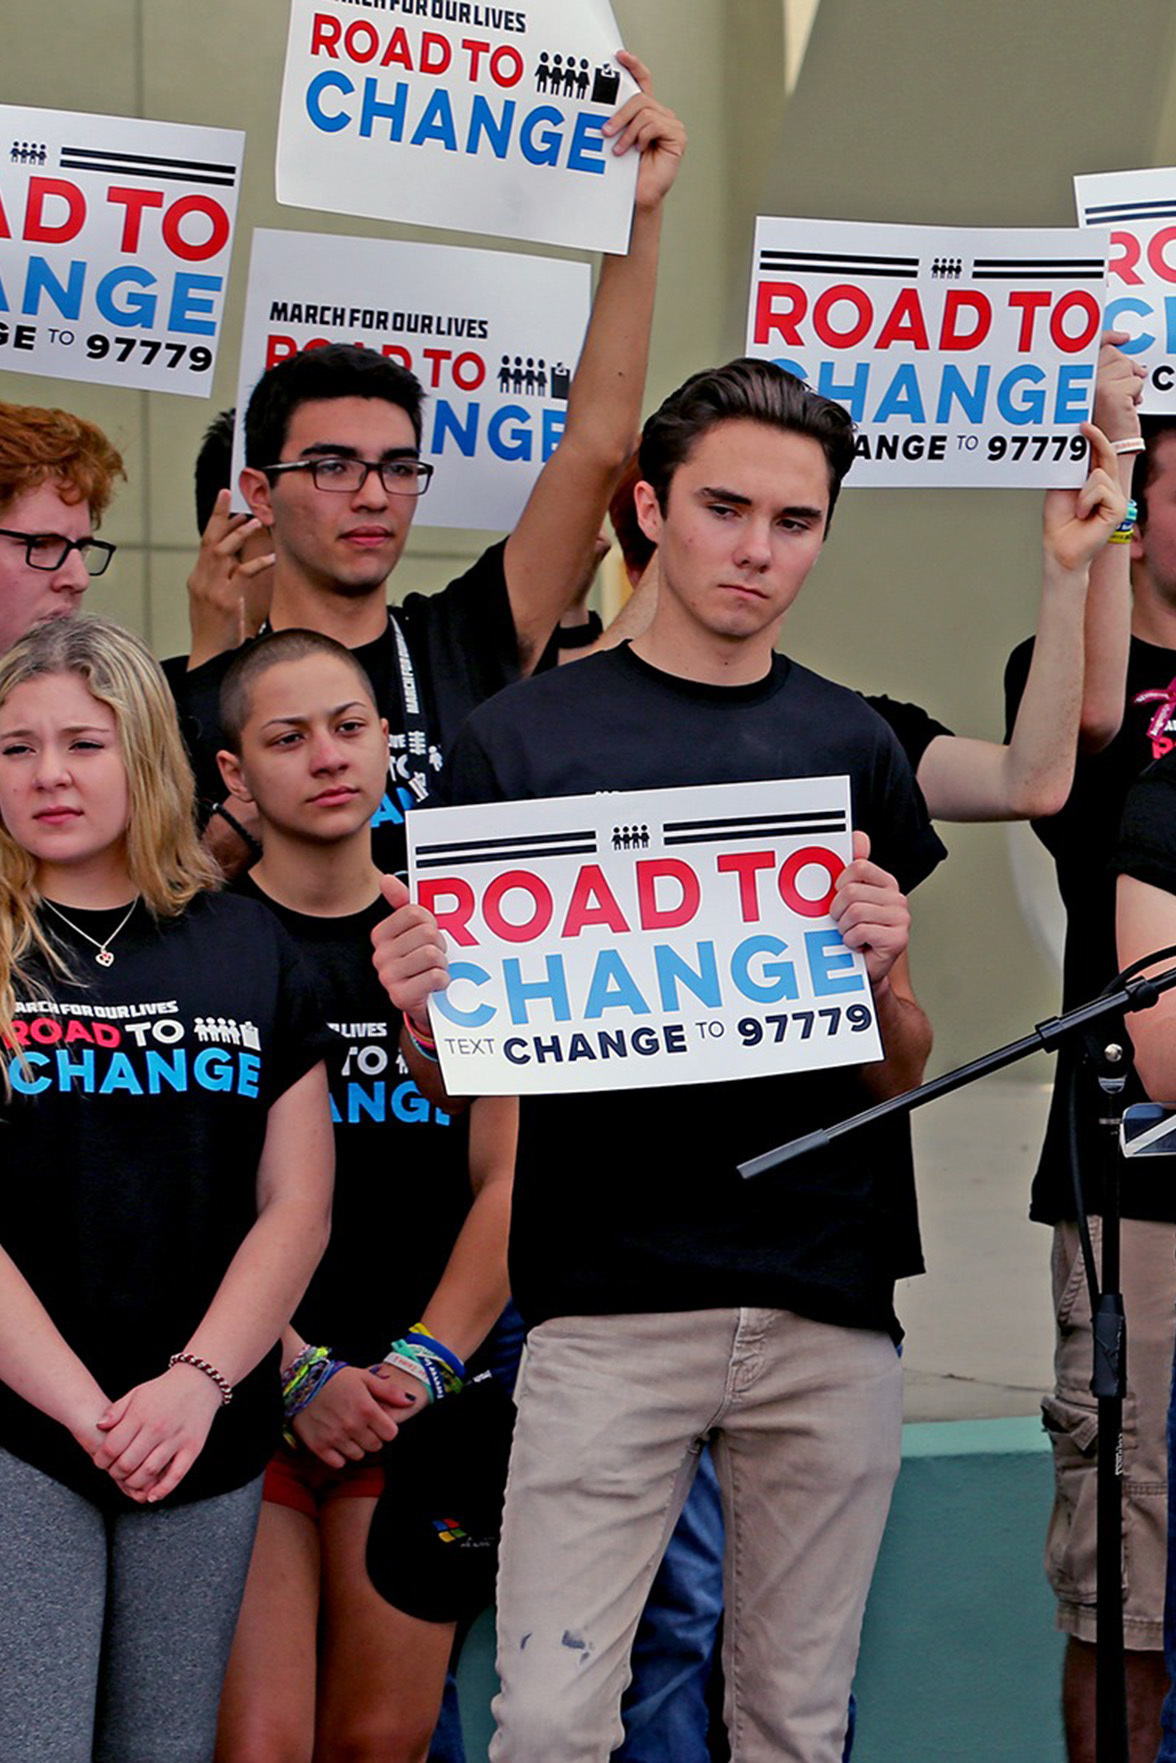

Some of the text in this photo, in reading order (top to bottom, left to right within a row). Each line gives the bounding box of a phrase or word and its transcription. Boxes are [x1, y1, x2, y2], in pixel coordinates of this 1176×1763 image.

[432, 1, 471, 23] OUR
[474, 7, 526, 33] LIVES
[311, 13, 524, 88] ROAD TO
[306, 70, 611, 175] CHANGE
[106, 185, 230, 262] TO
[0, 255, 223, 337] NGE
[270, 301, 489, 339] MARCH FOR OUR LIVES
[754, 281, 1101, 354] ROAD TO
[48, 328, 75, 346] TO
[86, 334, 213, 372] 97779
[423, 348, 486, 391] TO
[431, 399, 568, 464] NGE
[853, 434, 1087, 461] ANGE TO 97779
[417, 845, 847, 948] ROAD TO
[432, 929, 866, 1029] CHANGE
[4, 1017, 185, 1049] ROAD TO
[60, 1002, 94, 1018] FOR
[96, 1004, 130, 1020] OUR
[131, 1000, 180, 1017] LIVES
[341, 1022, 388, 1038] LIVES
[444, 1003, 873, 1065] TEXT CHANGE TO 97779
[9, 1047, 262, 1099] CHANGE
